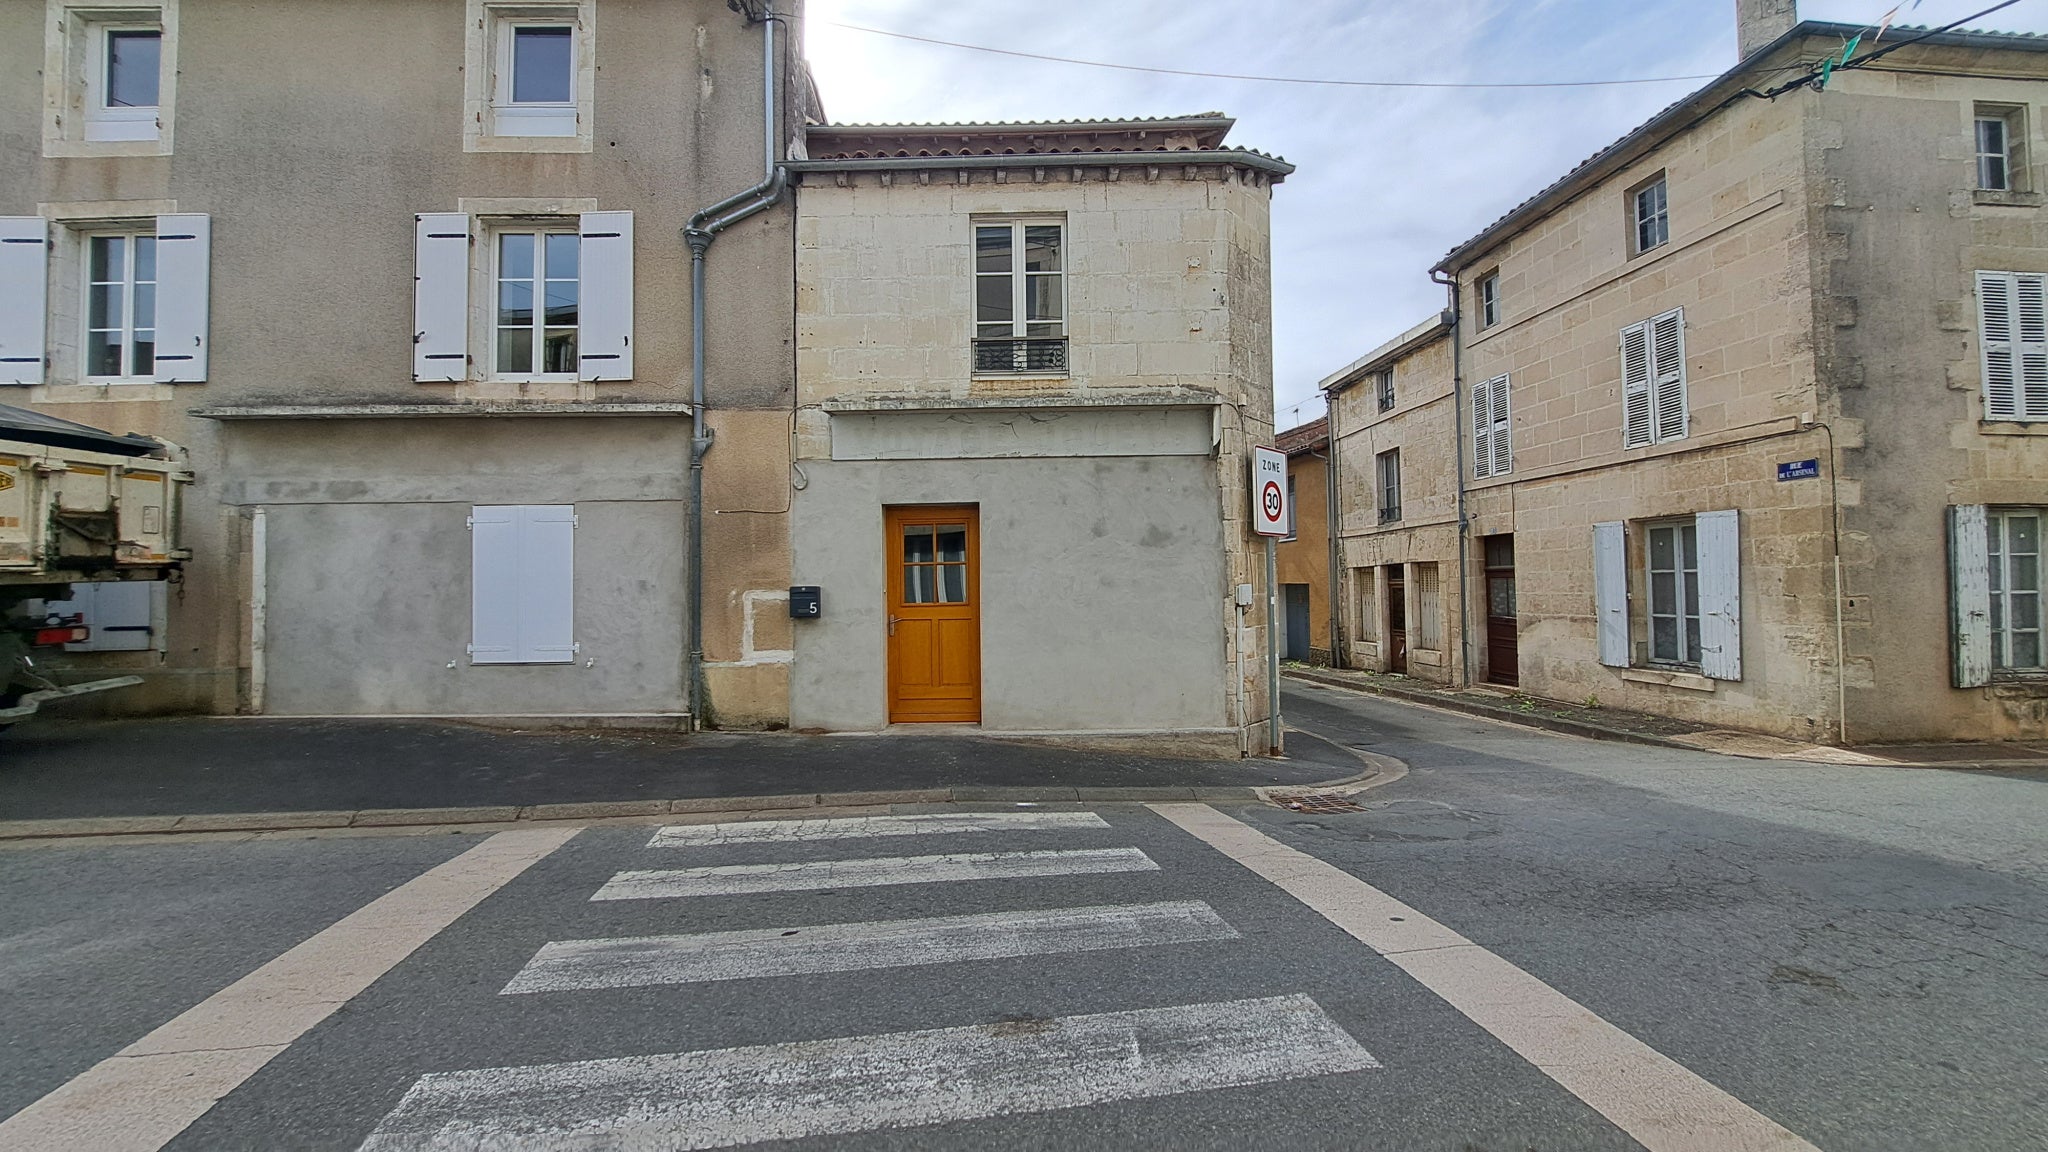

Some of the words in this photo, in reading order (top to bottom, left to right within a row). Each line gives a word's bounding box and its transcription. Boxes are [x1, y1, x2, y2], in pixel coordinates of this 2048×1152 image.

[1262, 459, 1281, 473] ZONE
[1789, 461, 1803, 470] RUE
[1266, 492, 1279, 511] 30
[809, 602, 818, 614] 5
